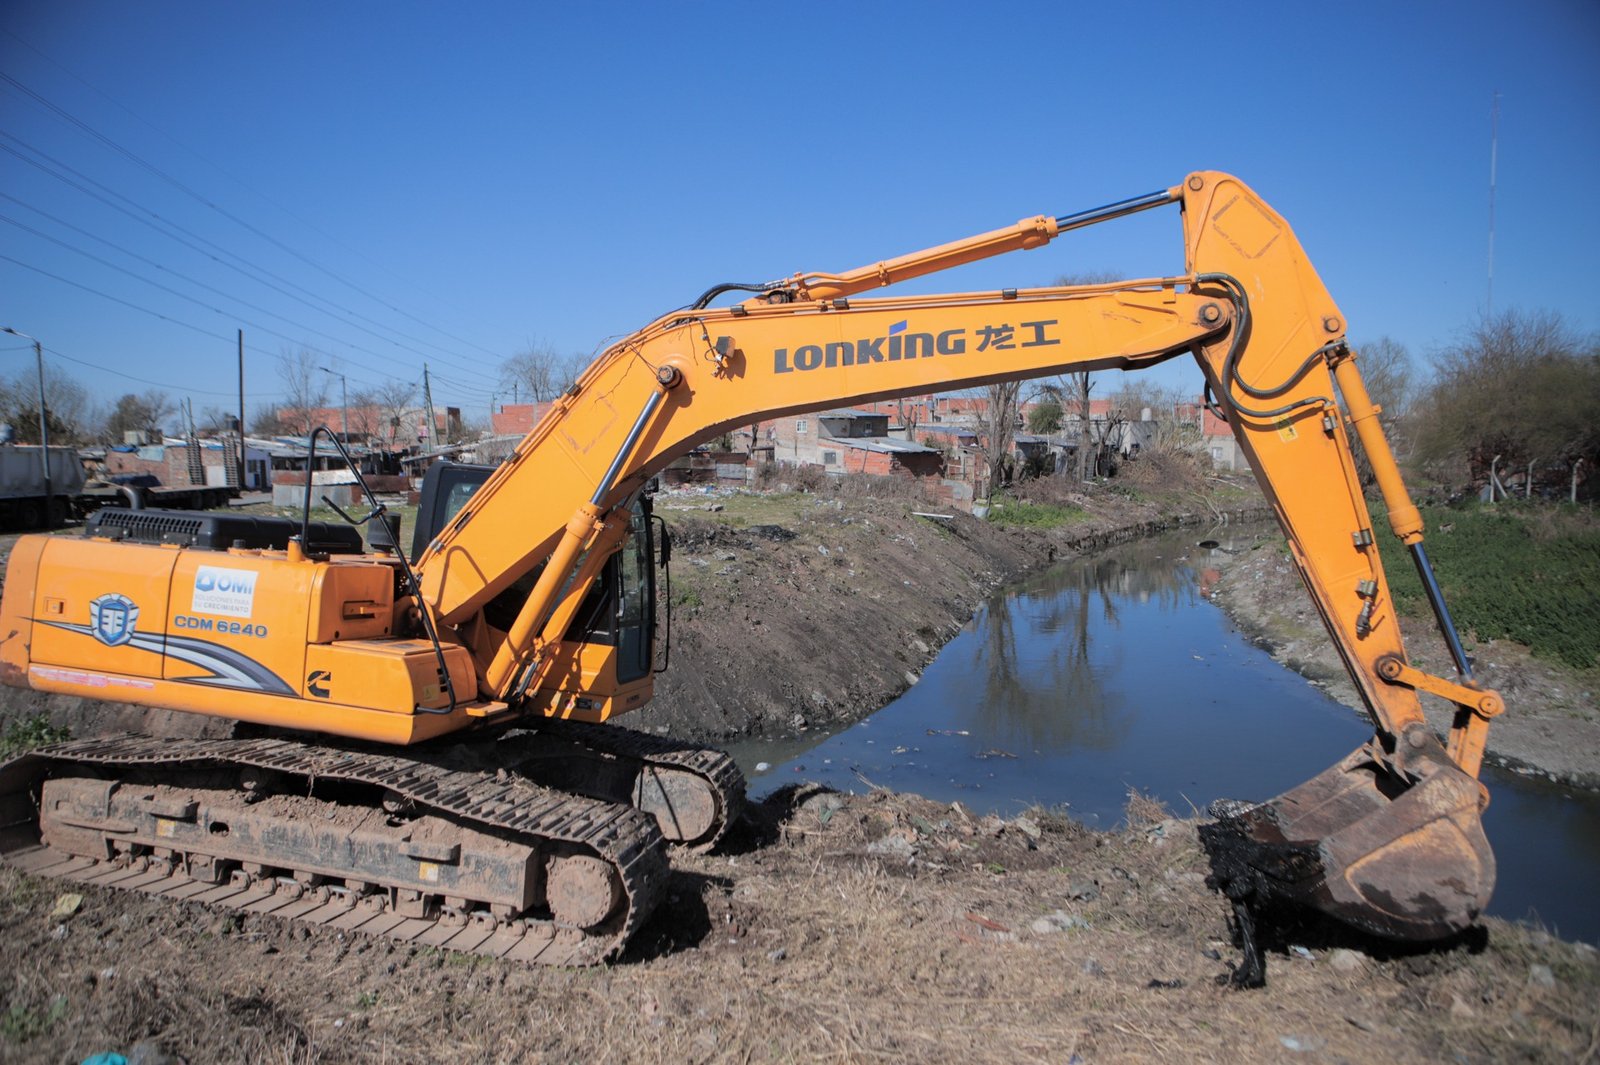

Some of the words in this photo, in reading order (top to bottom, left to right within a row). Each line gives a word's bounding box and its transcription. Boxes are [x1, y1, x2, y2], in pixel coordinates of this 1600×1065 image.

[975, 319, 1061, 352] 龙工
[217, 575, 252, 595] OMI
[204, 602, 249, 613] CRECIMIENTO
[174, 615, 213, 631] CDM
[217, 620, 268, 638] 6240
